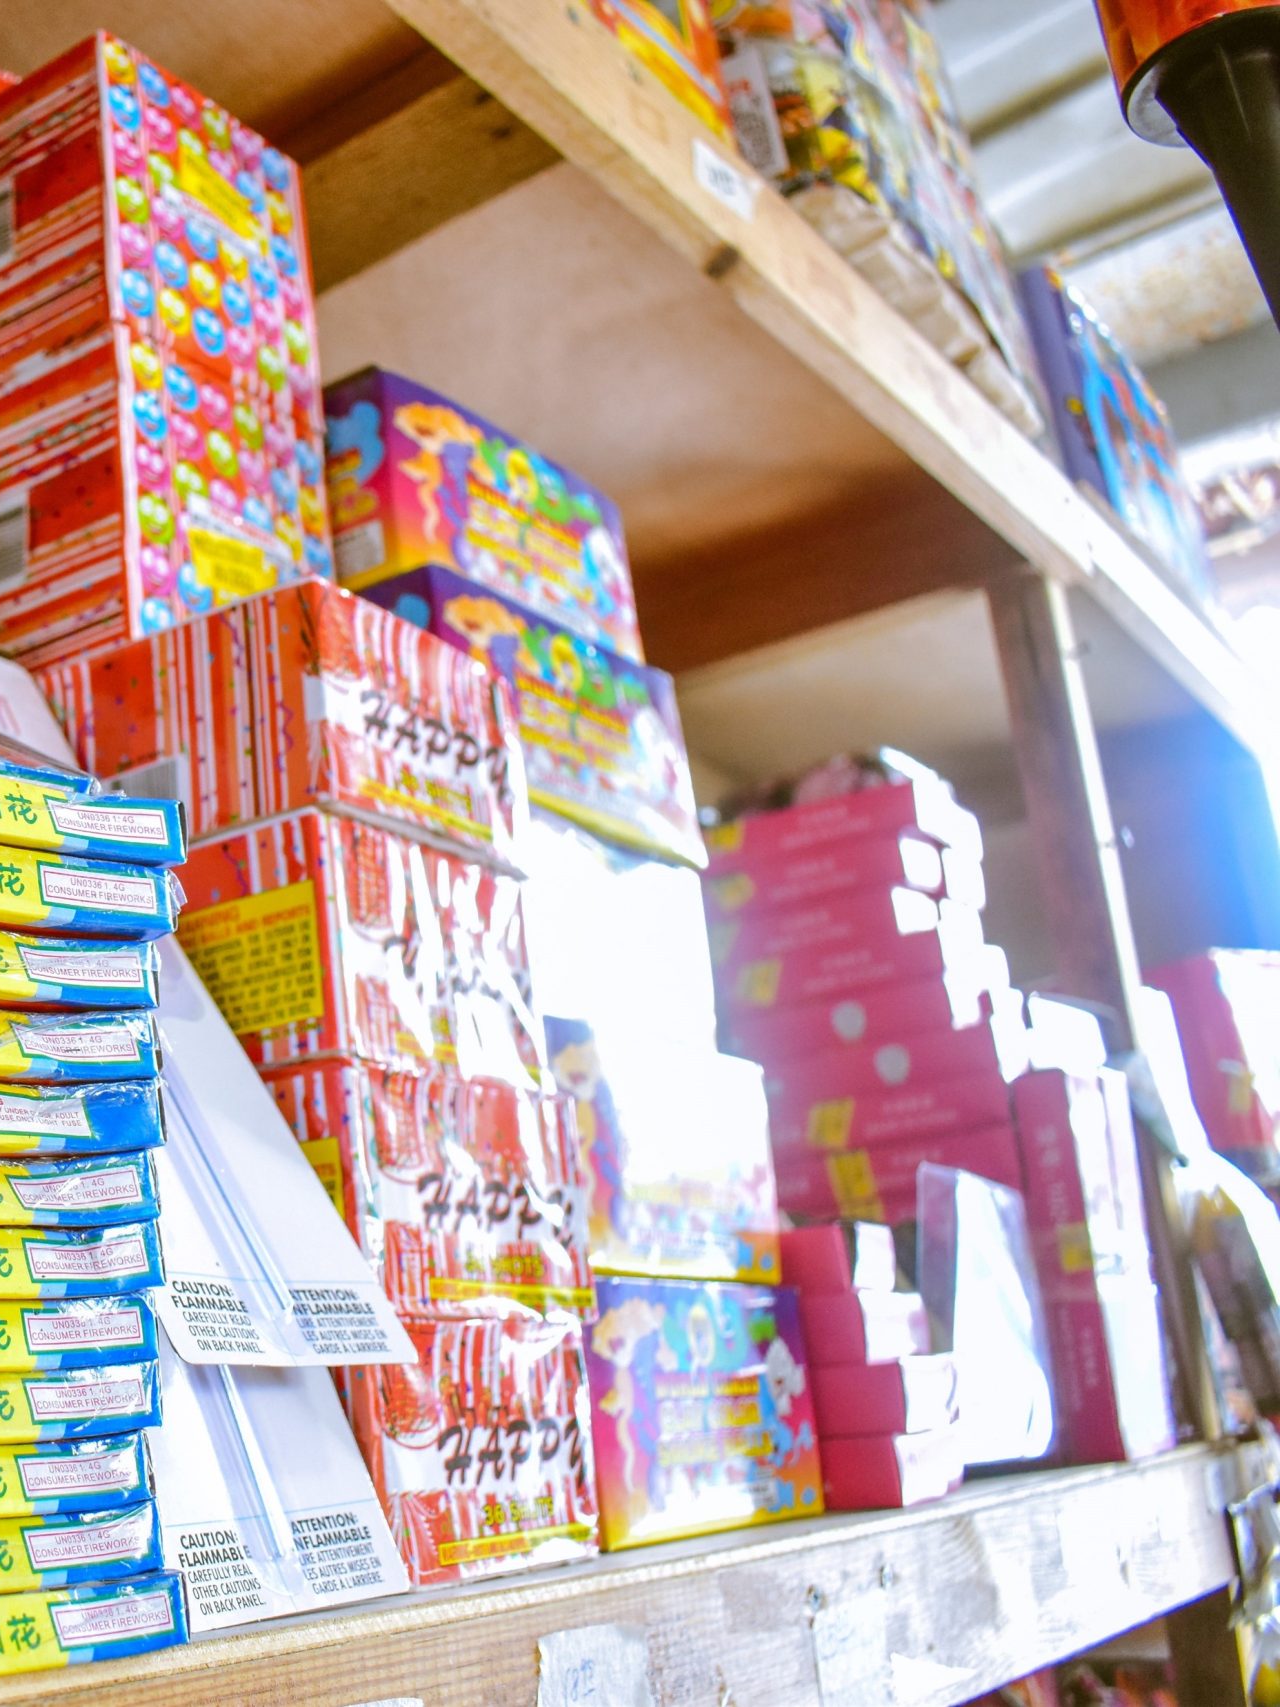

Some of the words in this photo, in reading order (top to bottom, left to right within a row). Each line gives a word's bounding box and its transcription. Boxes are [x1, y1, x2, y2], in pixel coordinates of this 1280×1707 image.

[58, 816, 105, 832] CONSUMER
[106, 822, 163, 836] FIREWORKS
[70, 877, 100, 889] UN0336
[47, 884, 97, 898] CONSUMER
[98, 890, 152, 905] FIREWORKS
[83, 968, 138, 979] FIREWORKS
[24, 1039, 73, 1054] CONSUMER
[22, 1190, 75, 1202] CONSUMER
[76, 1184, 135, 1199] FIREWORKS
[35, 1260, 85, 1271] CONSUMER
[84, 1253, 142, 1271] FIREWORKS
[172, 1280, 234, 1298] CAUTION:
[171, 1295, 249, 1313] FLAMMABLE
[293, 1302, 376, 1316] NFLAMMABLE
[182, 1311, 229, 1325] CAREFULLY
[229, 1314, 252, 1327] READ
[32, 1329, 82, 1341] CONSUMER
[83, 1325, 138, 1338] FIREWORKS
[188, 1325, 216, 1338] OTHER
[219, 1326, 260, 1340] CAUTIONS
[197, 1339, 212, 1351] ON
[212, 1339, 233, 1352] BACK
[55, 1388, 88, 1398] UN0336
[36, 1398, 86, 1410] CONSUMER
[438, 1417, 588, 1489] HAPPY
[29, 1474, 78, 1487] CONSUMER
[290, 1512, 359, 1535] ATTENTION:
[482, 1503, 505, 1527] 36
[179, 1530, 239, 1551] CAUTION:
[293, 1526, 372, 1552] NFLAMMABLE
[35, 1546, 84, 1559] CONSUMER
[178, 1545, 252, 1568] FLAMMABLE
[317, 1542, 374, 1561] ATTENTIVEMENT
[187, 1567, 231, 1584] CAREFULLY
[303, 1567, 319, 1581] LES
[319, 1562, 348, 1579] AUTRES
[348, 1558, 371, 1574] MISES
[371, 1555, 382, 1569] EN
[192, 1584, 220, 1600] OTHER
[220, 1577, 262, 1597] CAUTIONS
[312, 1580, 340, 1596] GARDE
[200, 1602, 214, 1616] ON
[214, 1598, 237, 1614] BACK
[111, 1609, 168, 1629] FIREWORKS
